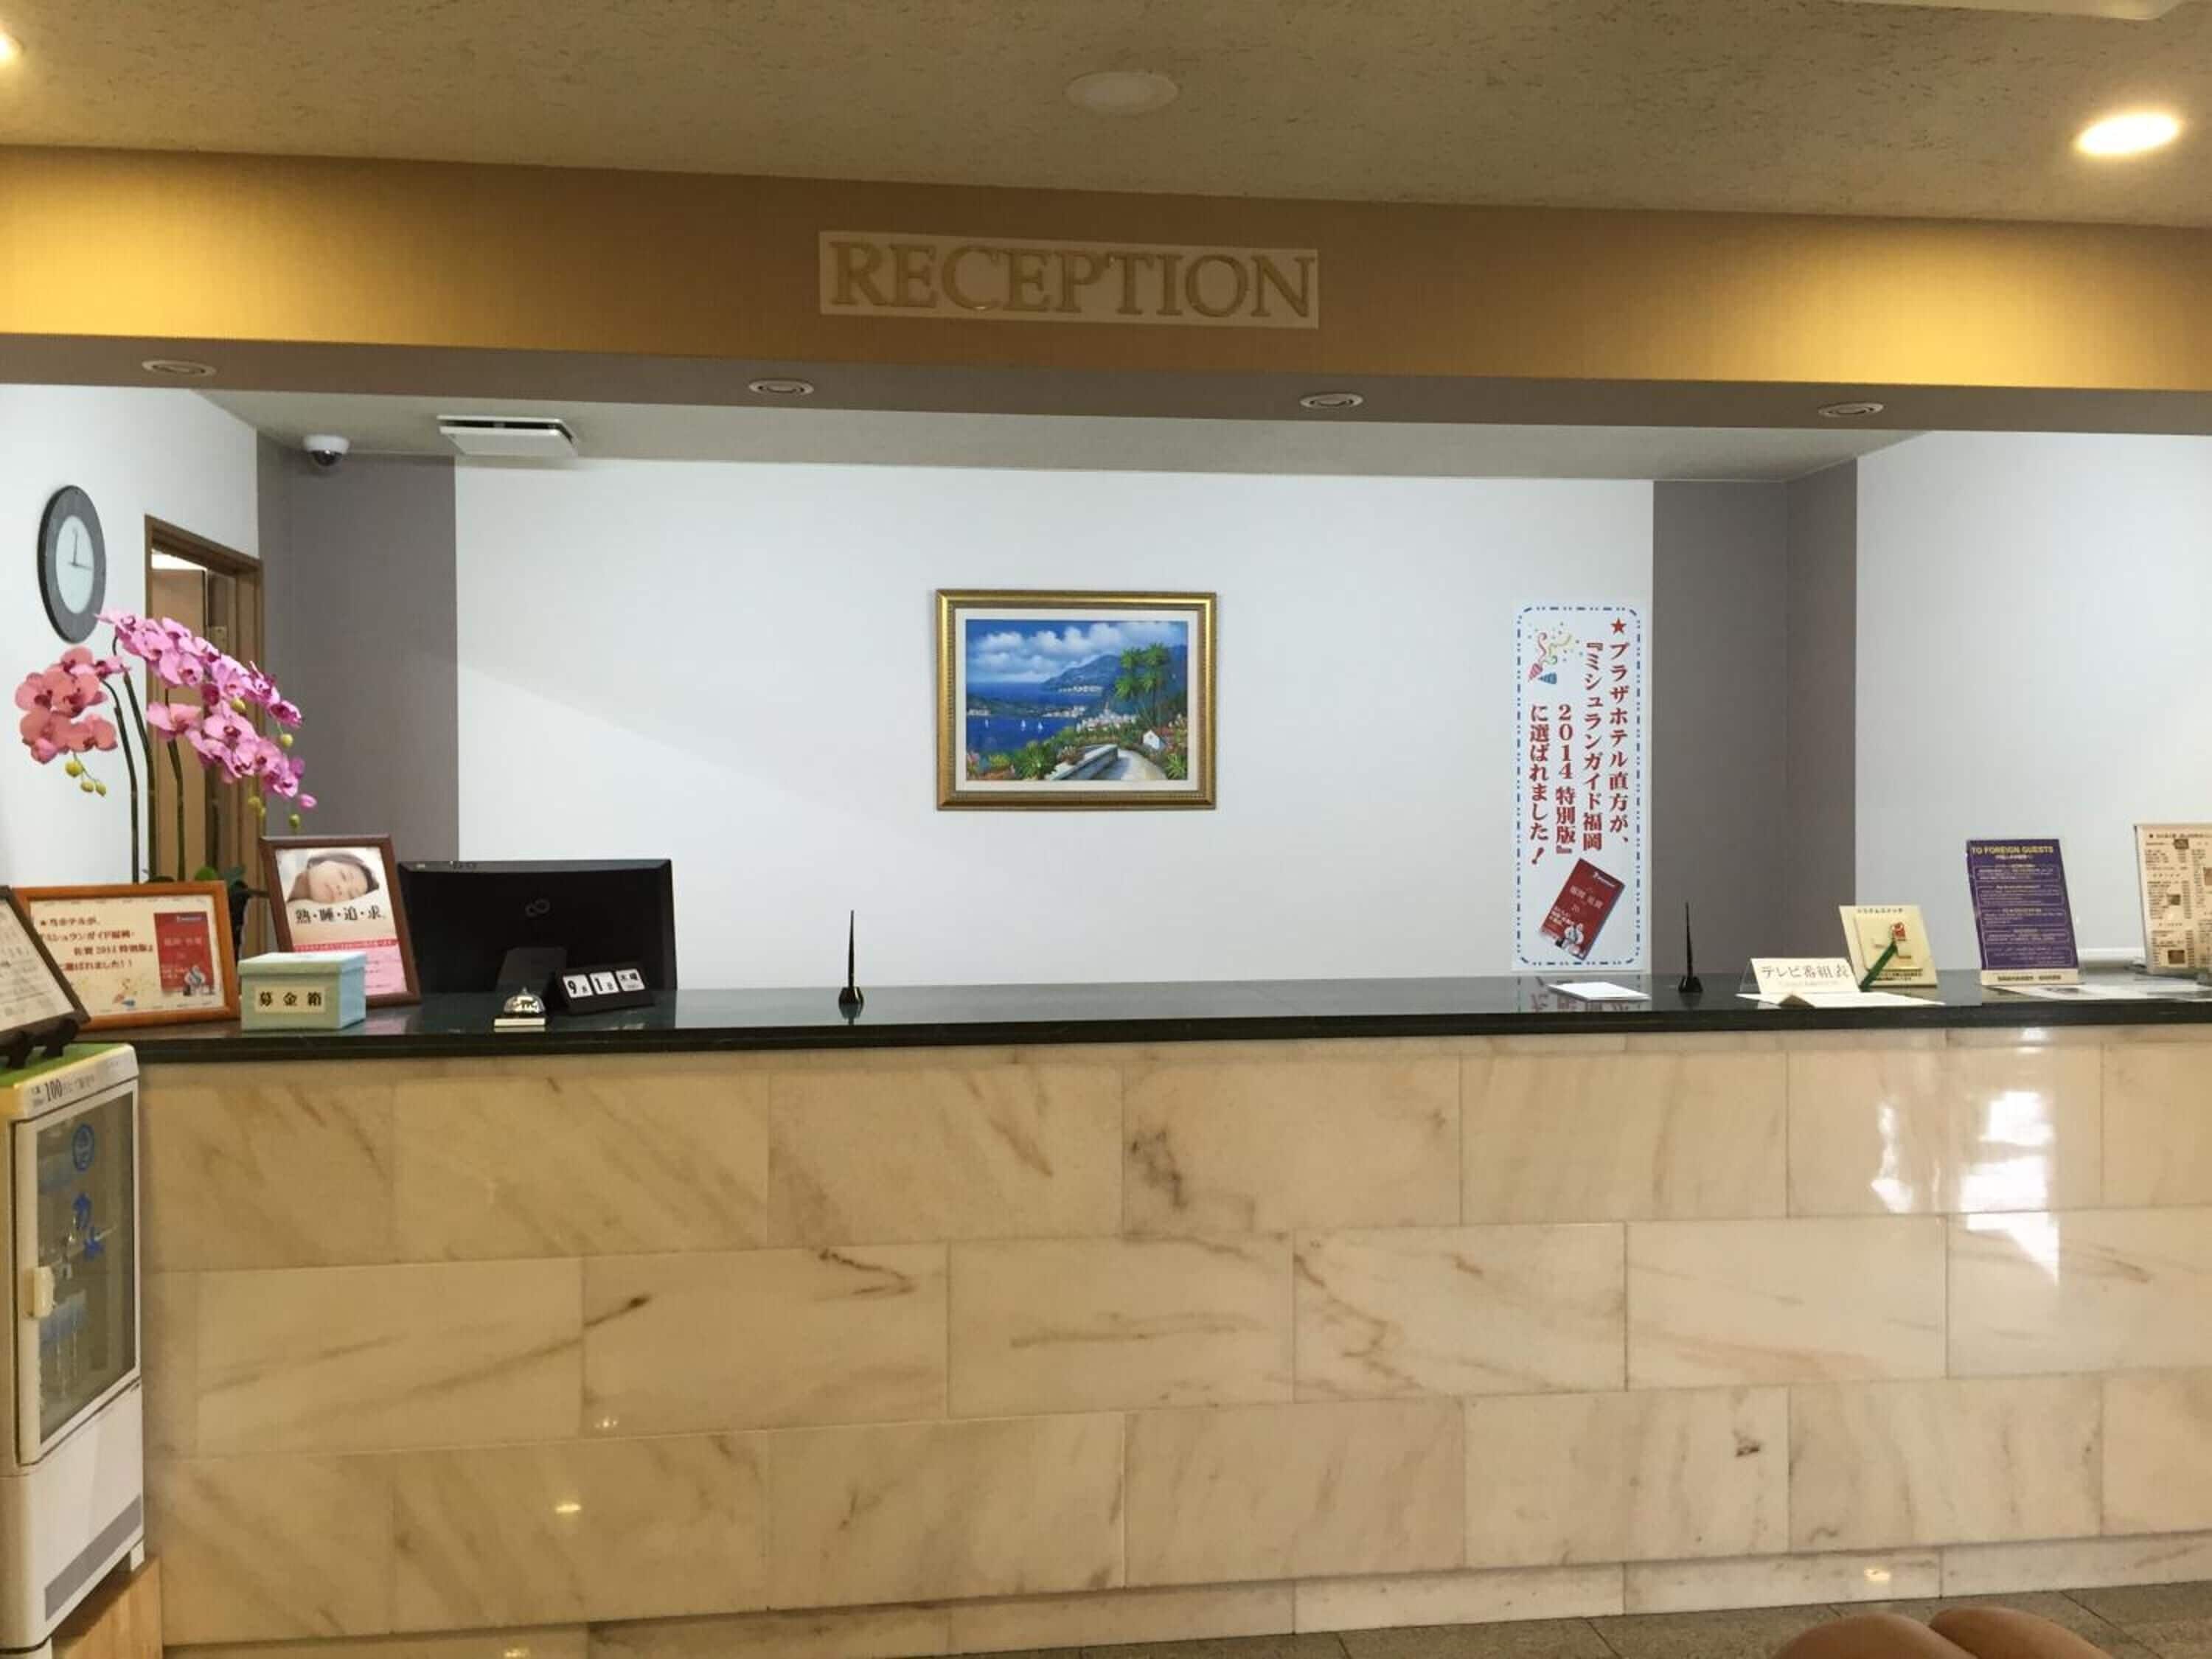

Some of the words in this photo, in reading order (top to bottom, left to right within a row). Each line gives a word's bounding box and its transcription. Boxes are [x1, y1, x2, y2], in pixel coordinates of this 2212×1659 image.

[830, 241, 1315, 318] RECEPTION
[1761, 964, 1849, 979] テレビ番組表
[260, 991, 322, 1007] 募金箱
